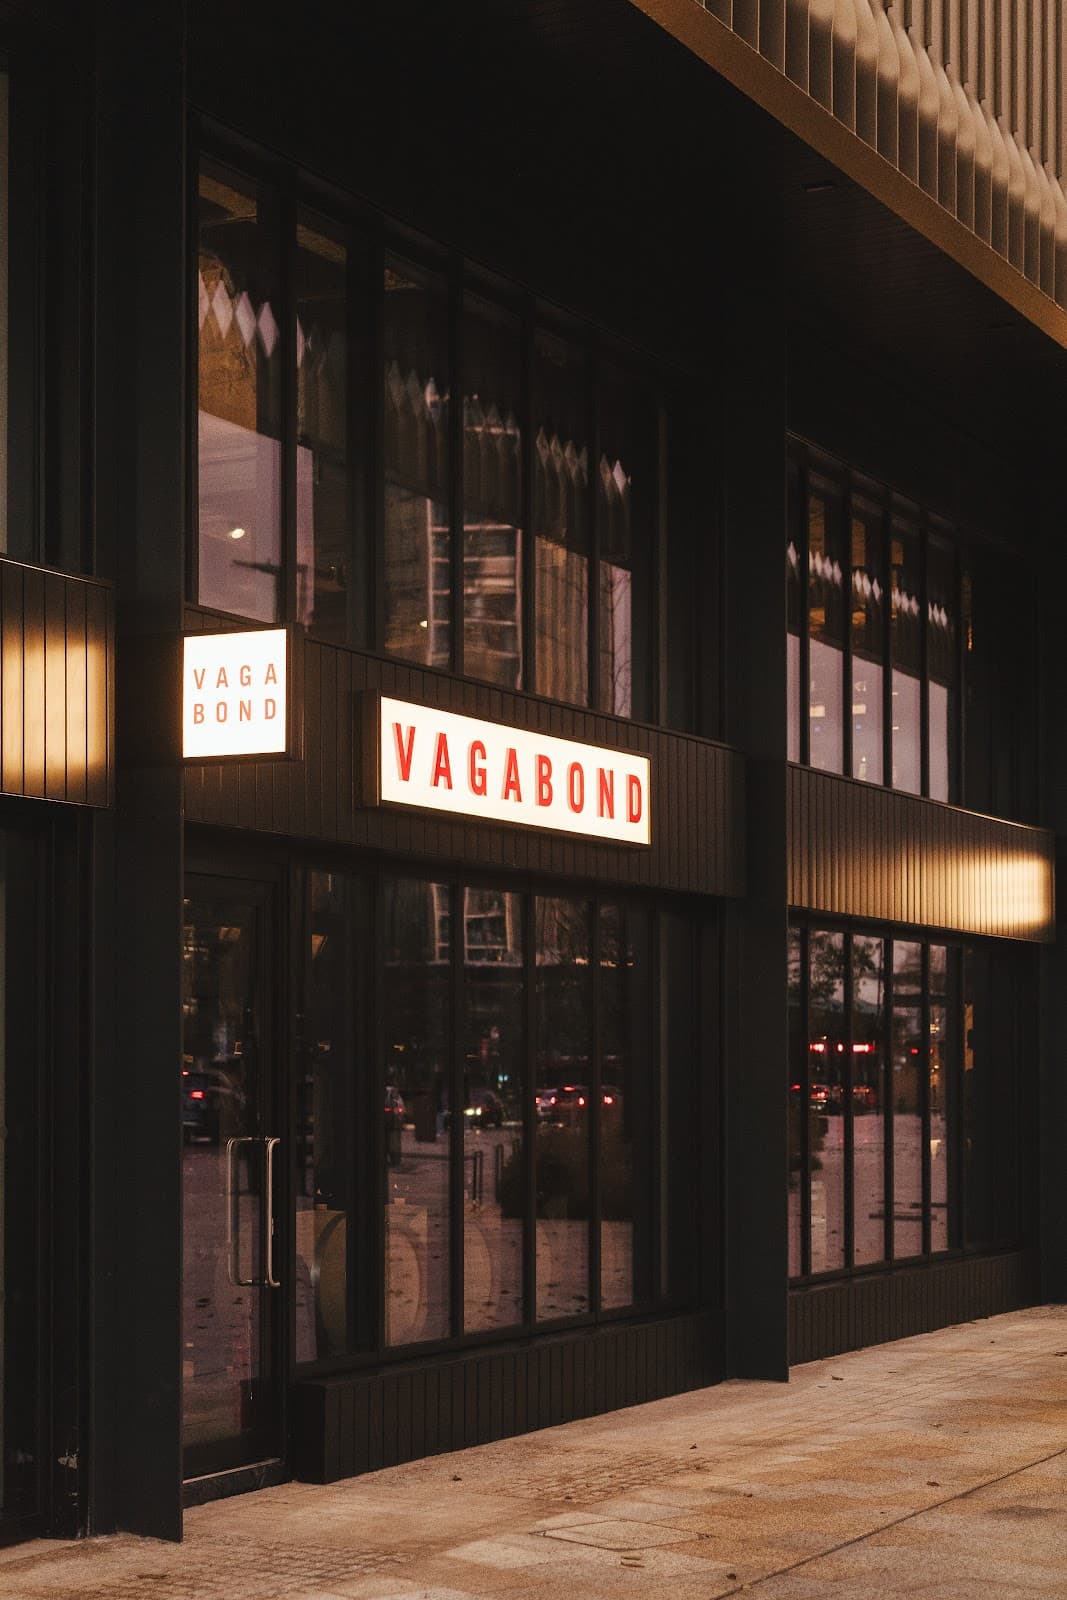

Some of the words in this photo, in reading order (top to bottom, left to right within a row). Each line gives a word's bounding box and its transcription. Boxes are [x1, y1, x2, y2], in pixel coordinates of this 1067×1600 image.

[193, 663, 277, 690] VAGA
[193, 698, 277, 725] BOND
[392, 722, 643, 824] VAGABOND
